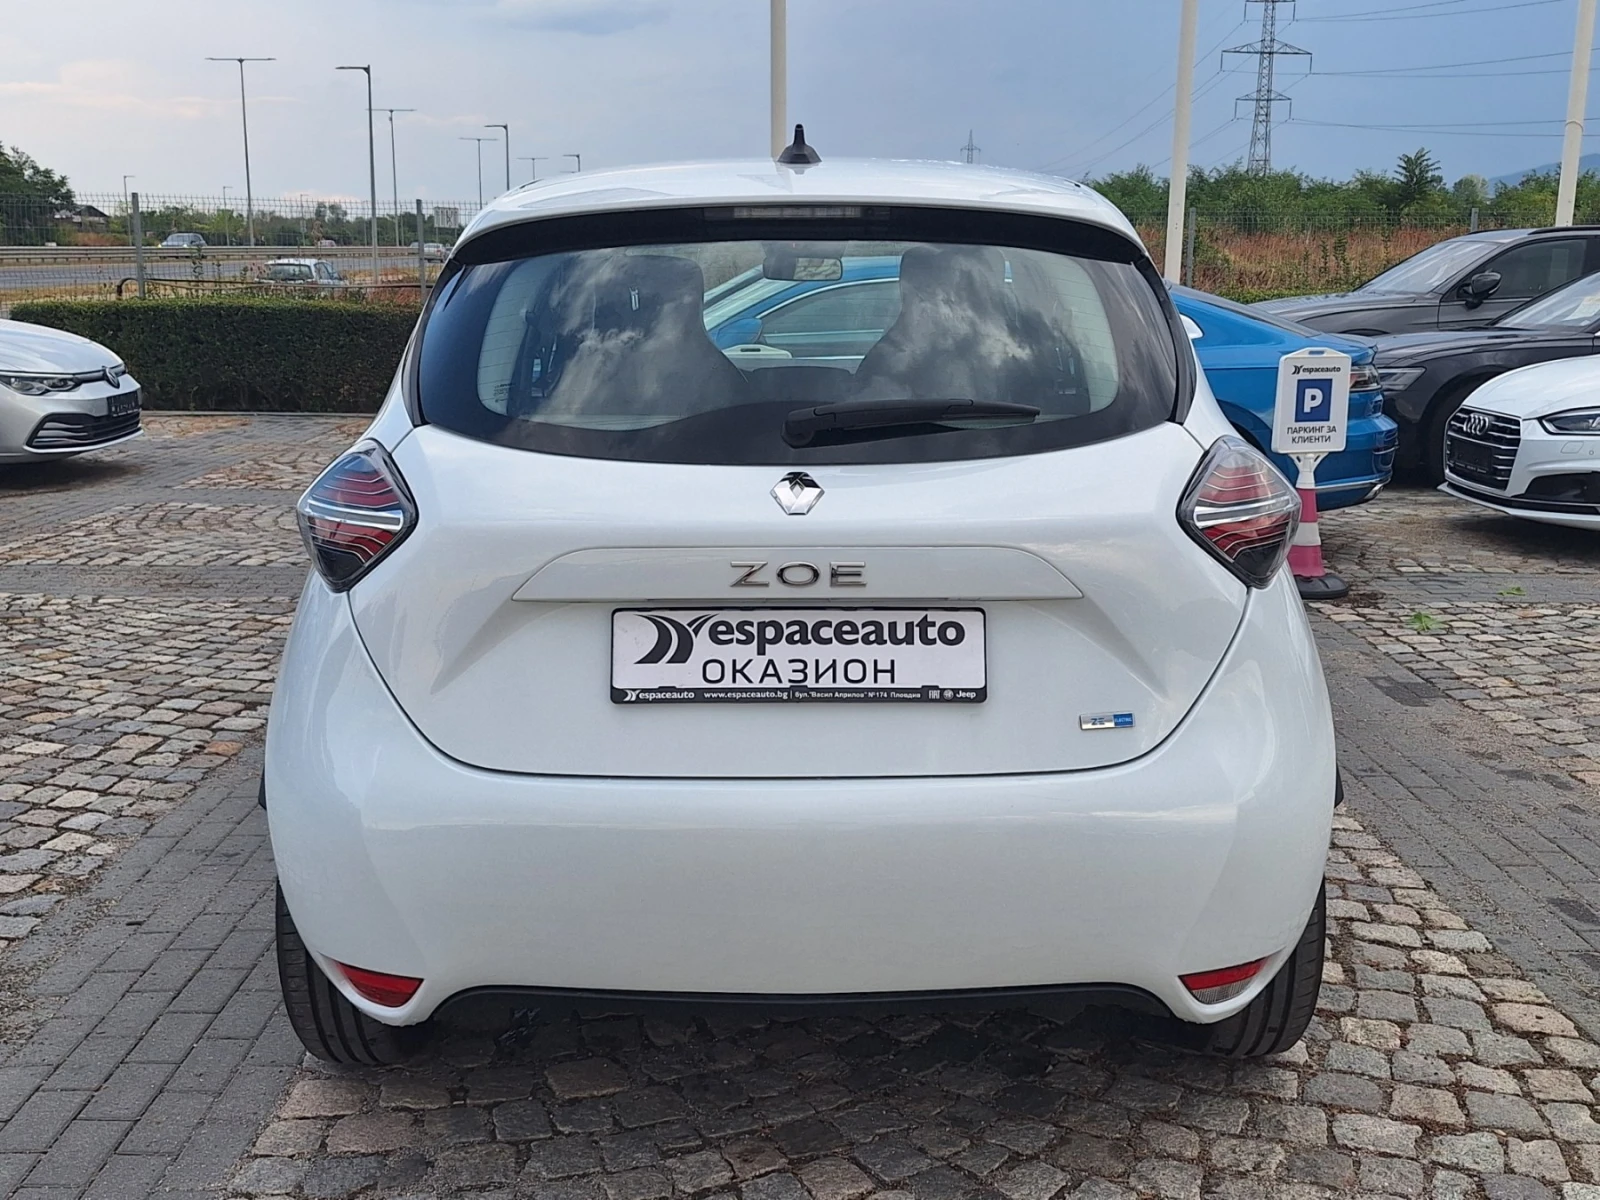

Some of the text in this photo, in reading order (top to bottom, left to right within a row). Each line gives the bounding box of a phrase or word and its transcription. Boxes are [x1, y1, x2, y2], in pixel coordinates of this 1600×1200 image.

[1302, 366, 1341, 374] espaceauto
[1303, 388, 1323, 413] P
[1287, 426, 1325, 434] ПАРКИНГ
[1291, 436, 1331, 444] КЛИЕНТИ
[730, 561, 867, 588] ZOE
[708, 614, 965, 656] espaceauto
[702, 658, 895, 684] ОКАЗИОН
[638, 690, 695, 699] espaceauto
[704, 690, 788, 699] www.espaceauto.bg
[928, 690, 941, 699] FIAT
[956, 690, 976, 699] Jeep
